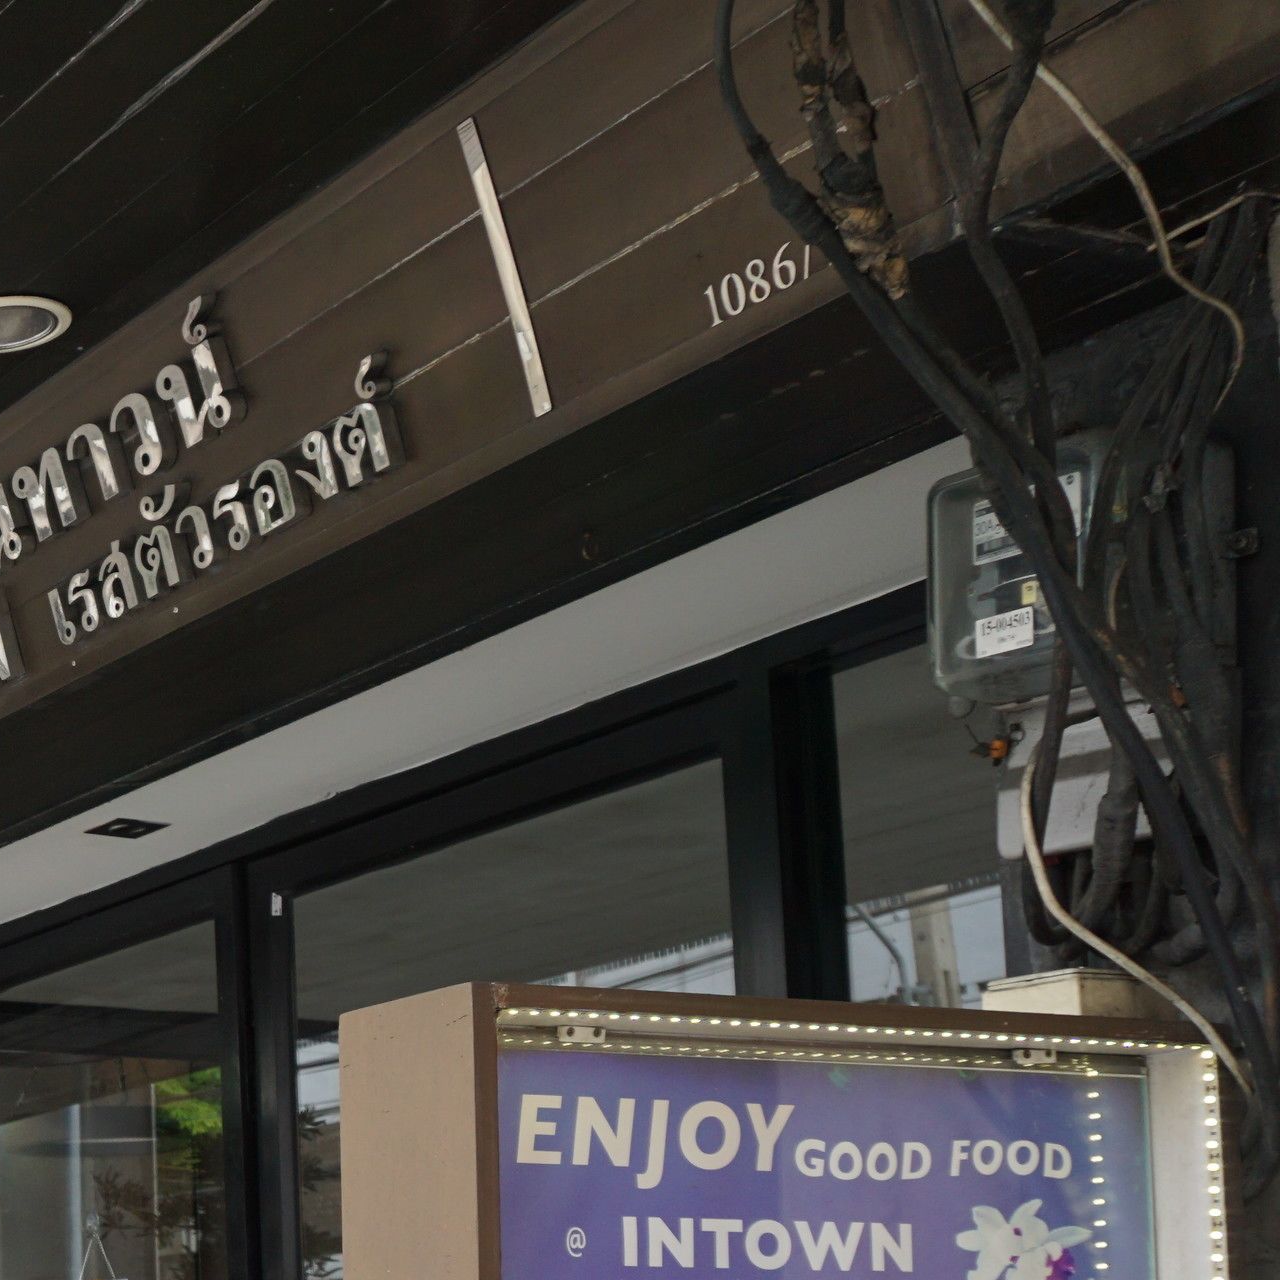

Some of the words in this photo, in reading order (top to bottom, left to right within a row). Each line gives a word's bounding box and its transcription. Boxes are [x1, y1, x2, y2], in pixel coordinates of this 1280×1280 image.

[516, 1093, 795, 1190] ENJOY
[794, 1138, 932, 1181] GOOD
[950, 1139, 1073, 1180] FOOD
[566, 1227, 587, 1258] @
[622, 1216, 914, 1273] INTOWN
